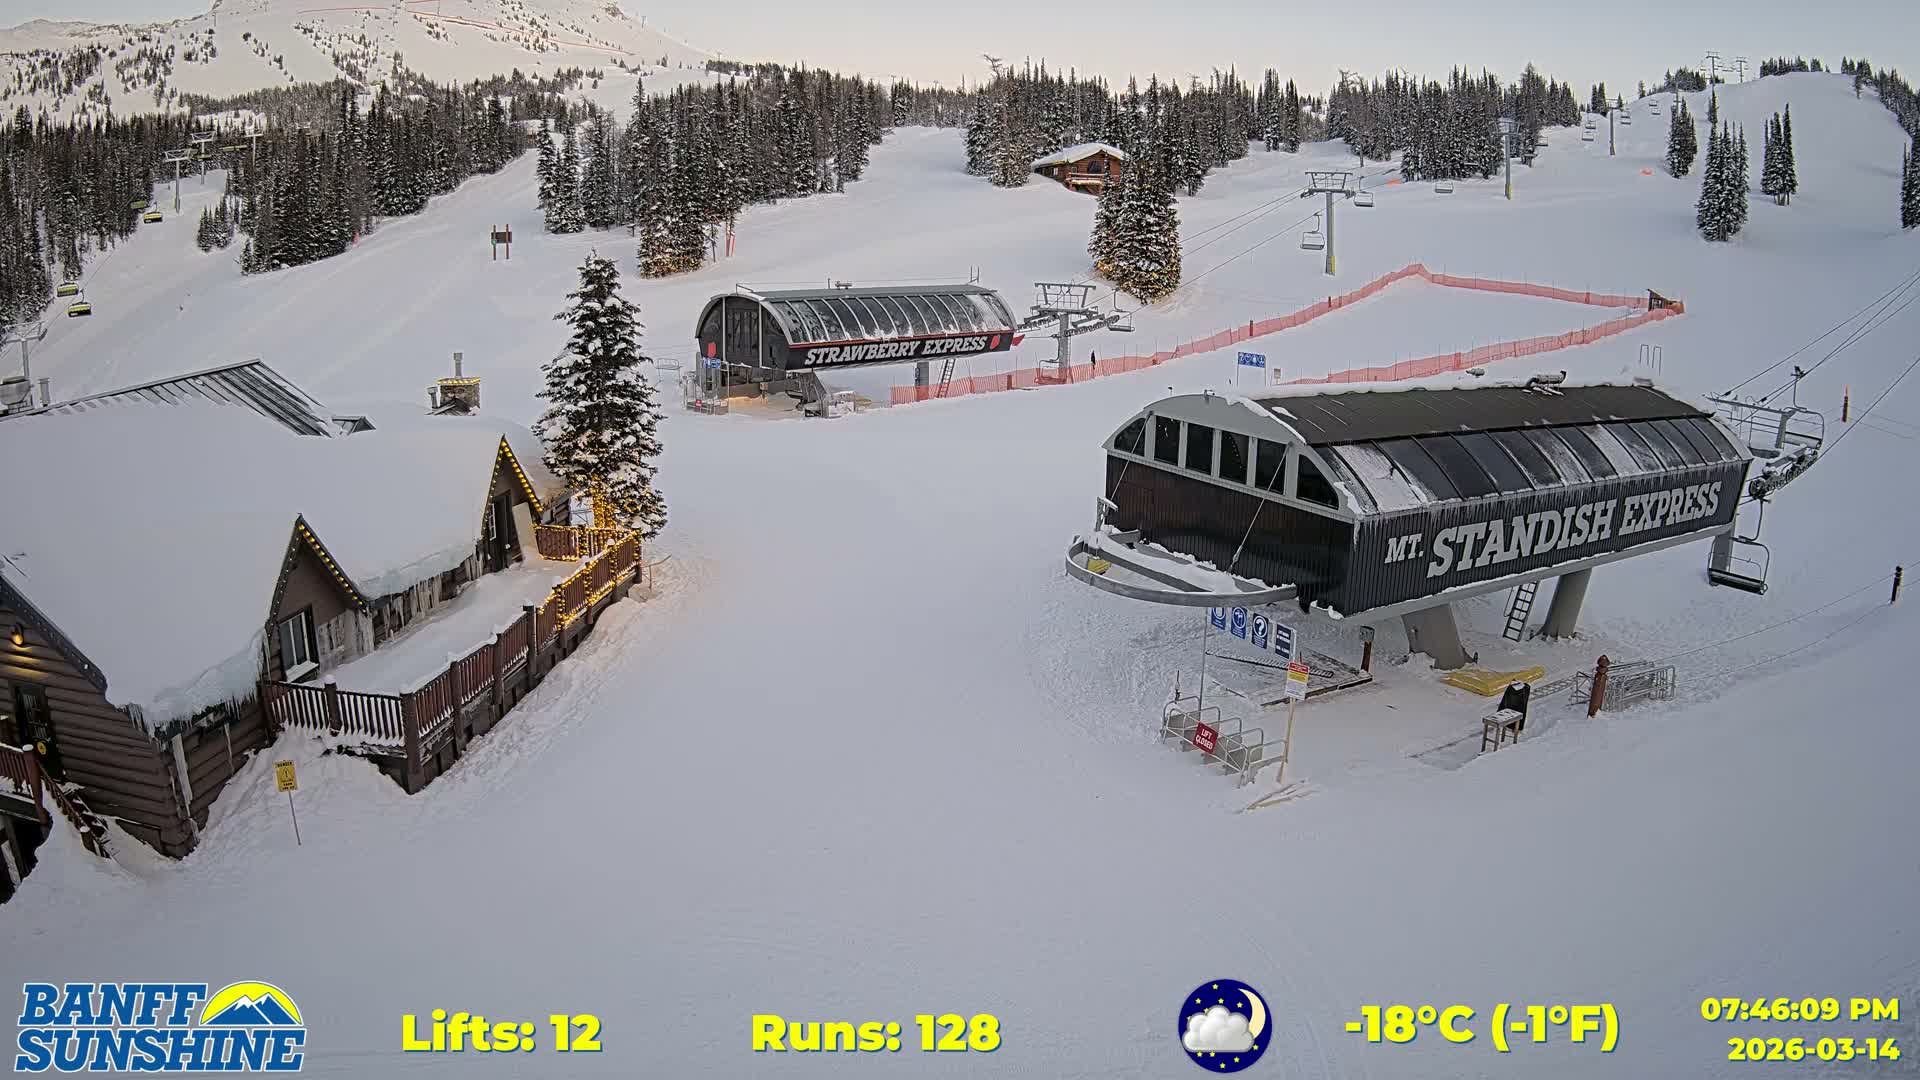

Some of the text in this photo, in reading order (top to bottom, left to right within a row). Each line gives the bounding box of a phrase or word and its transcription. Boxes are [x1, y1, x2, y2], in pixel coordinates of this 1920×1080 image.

[804, 336, 988, 365] STRAWBERRY EXPRESS
[1384, 481, 1722, 578] MT. STANDISH EXPRESS
[1195, 735, 1214, 750] CLOSED
[1201, 728, 1213, 740] LIFT
